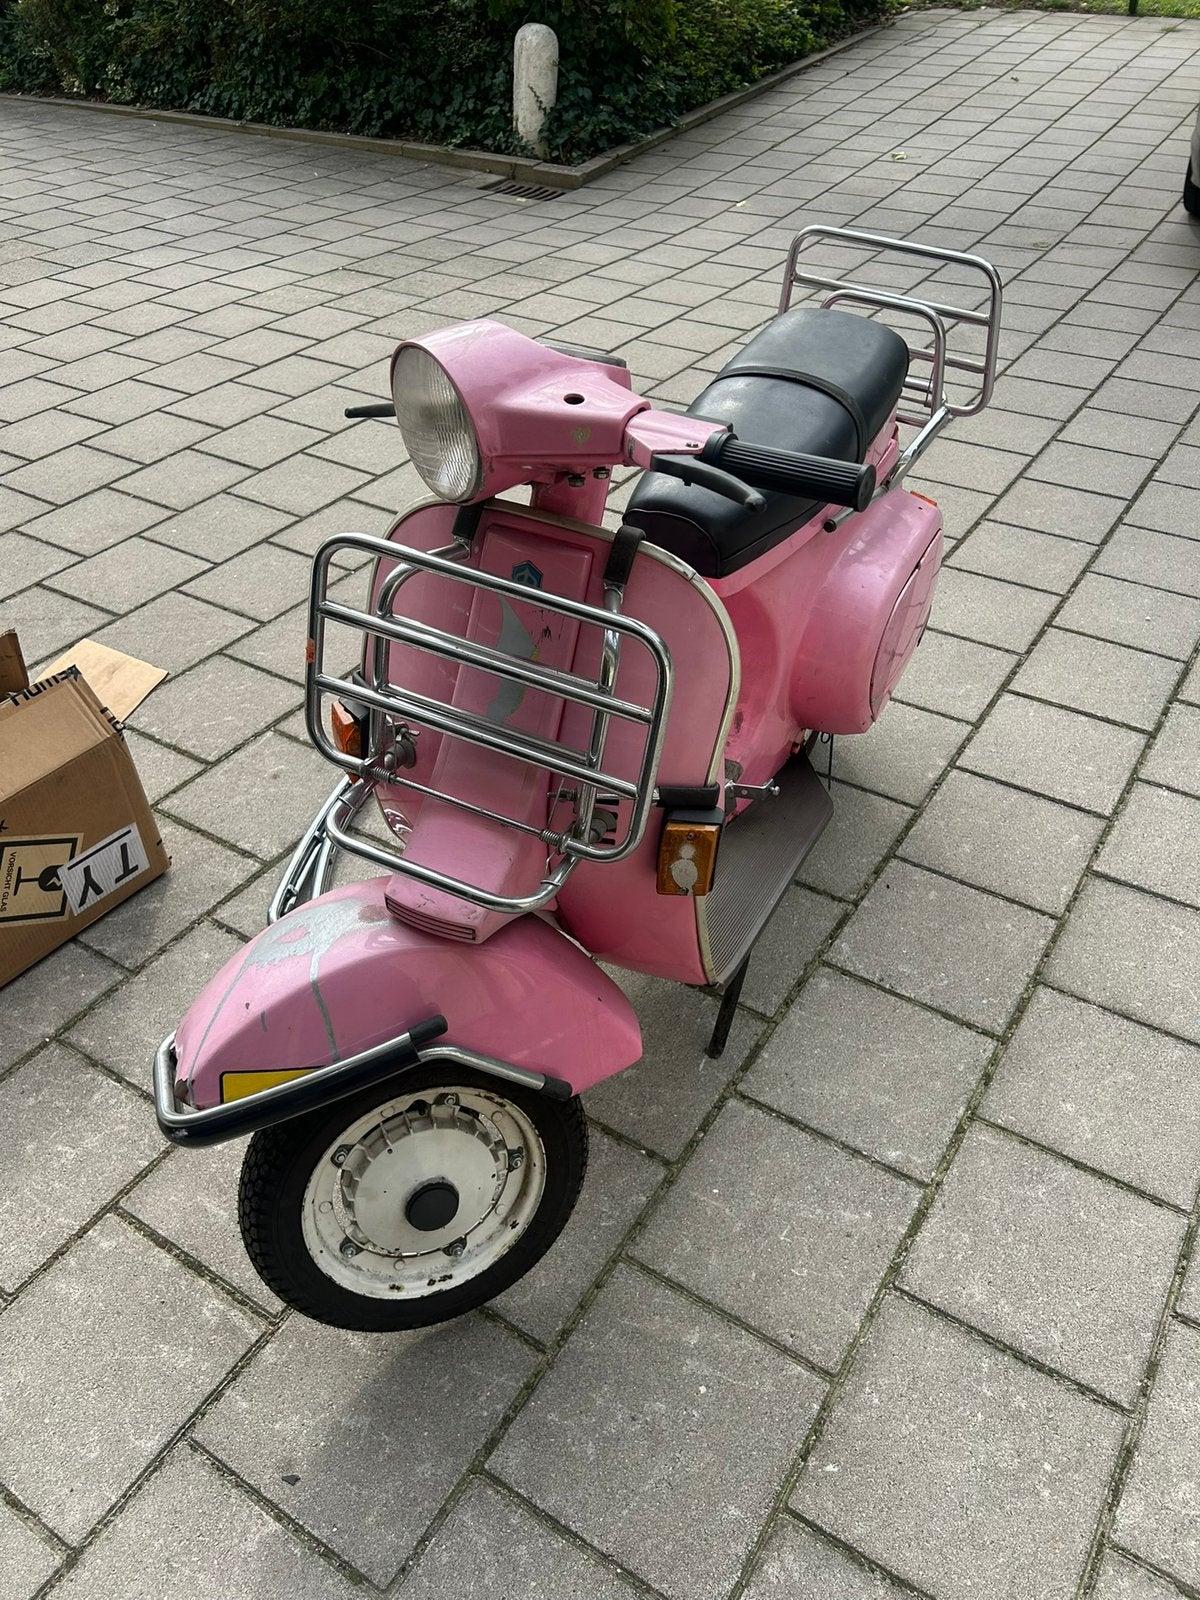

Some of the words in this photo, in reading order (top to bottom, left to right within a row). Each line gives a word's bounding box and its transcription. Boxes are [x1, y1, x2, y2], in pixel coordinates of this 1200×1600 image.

[4, 851, 17, 892] VORSICHT
[78, 842, 139, 908] TY
[0, 892, 10, 913] GLAS
